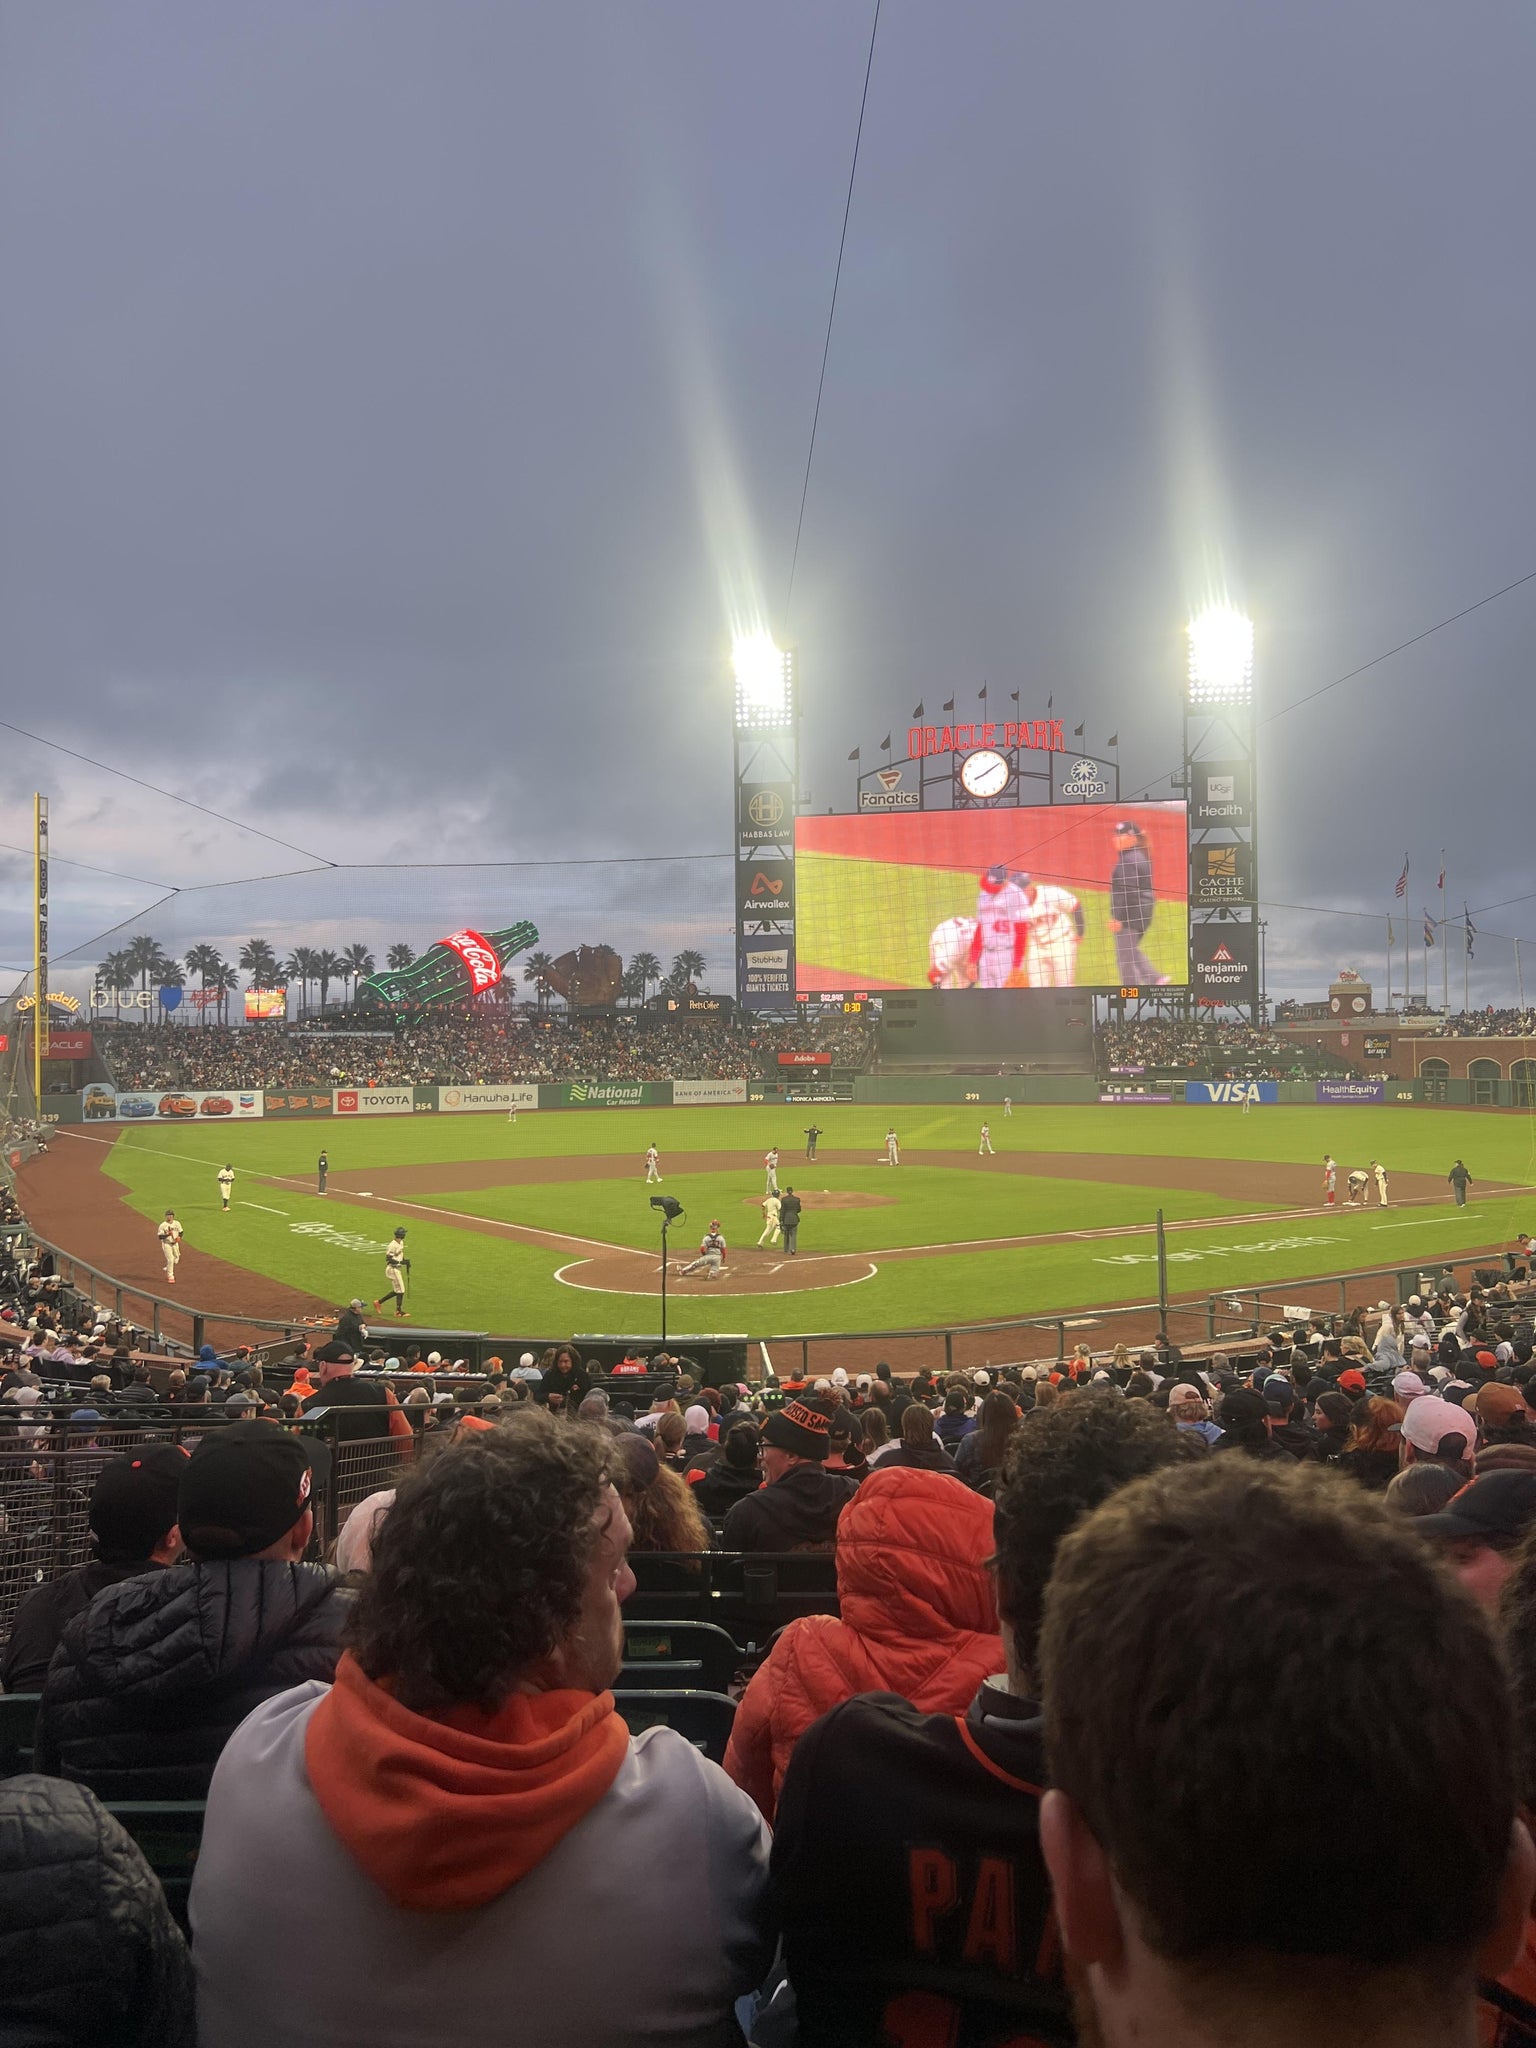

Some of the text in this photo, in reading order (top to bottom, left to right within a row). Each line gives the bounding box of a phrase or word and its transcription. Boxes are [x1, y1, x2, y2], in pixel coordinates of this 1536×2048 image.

[908, 719, 1066, 760] ORACLE PARK
[1065, 782, 1104, 796] coupa
[1210, 784, 1232, 794] UCSF
[861, 793, 919, 805] Fanatics
[1199, 805, 1242, 816] Health
[1199, 877, 1245, 887] CACHE
[1200, 887, 1242, 897] CREEK
[744, 900, 790, 909] Airwallex
[1197, 963, 1248, 974] Benjamin
[763, 974, 788, 982] VERIFIED
[1204, 974, 1241, 983] Moore
[746, 983, 789, 992] GIANTS TICKETS
[90, 985, 152, 1008] blue
[1121, 988, 1138, 998] 0:30
[16, 991, 81, 1012] Ghiardelli
[844, 1003, 860, 1012] 0:30
[587, 1086, 643, 1099] National
[1203, 1084, 1261, 1102] VISA
[1322, 1085, 1378, 1095] HealthEquity
[363, 1095, 410, 1105] TOYOTA
[464, 1092, 533, 1103] Hanwha Life
[41, 1113, 59, 1122] 339
